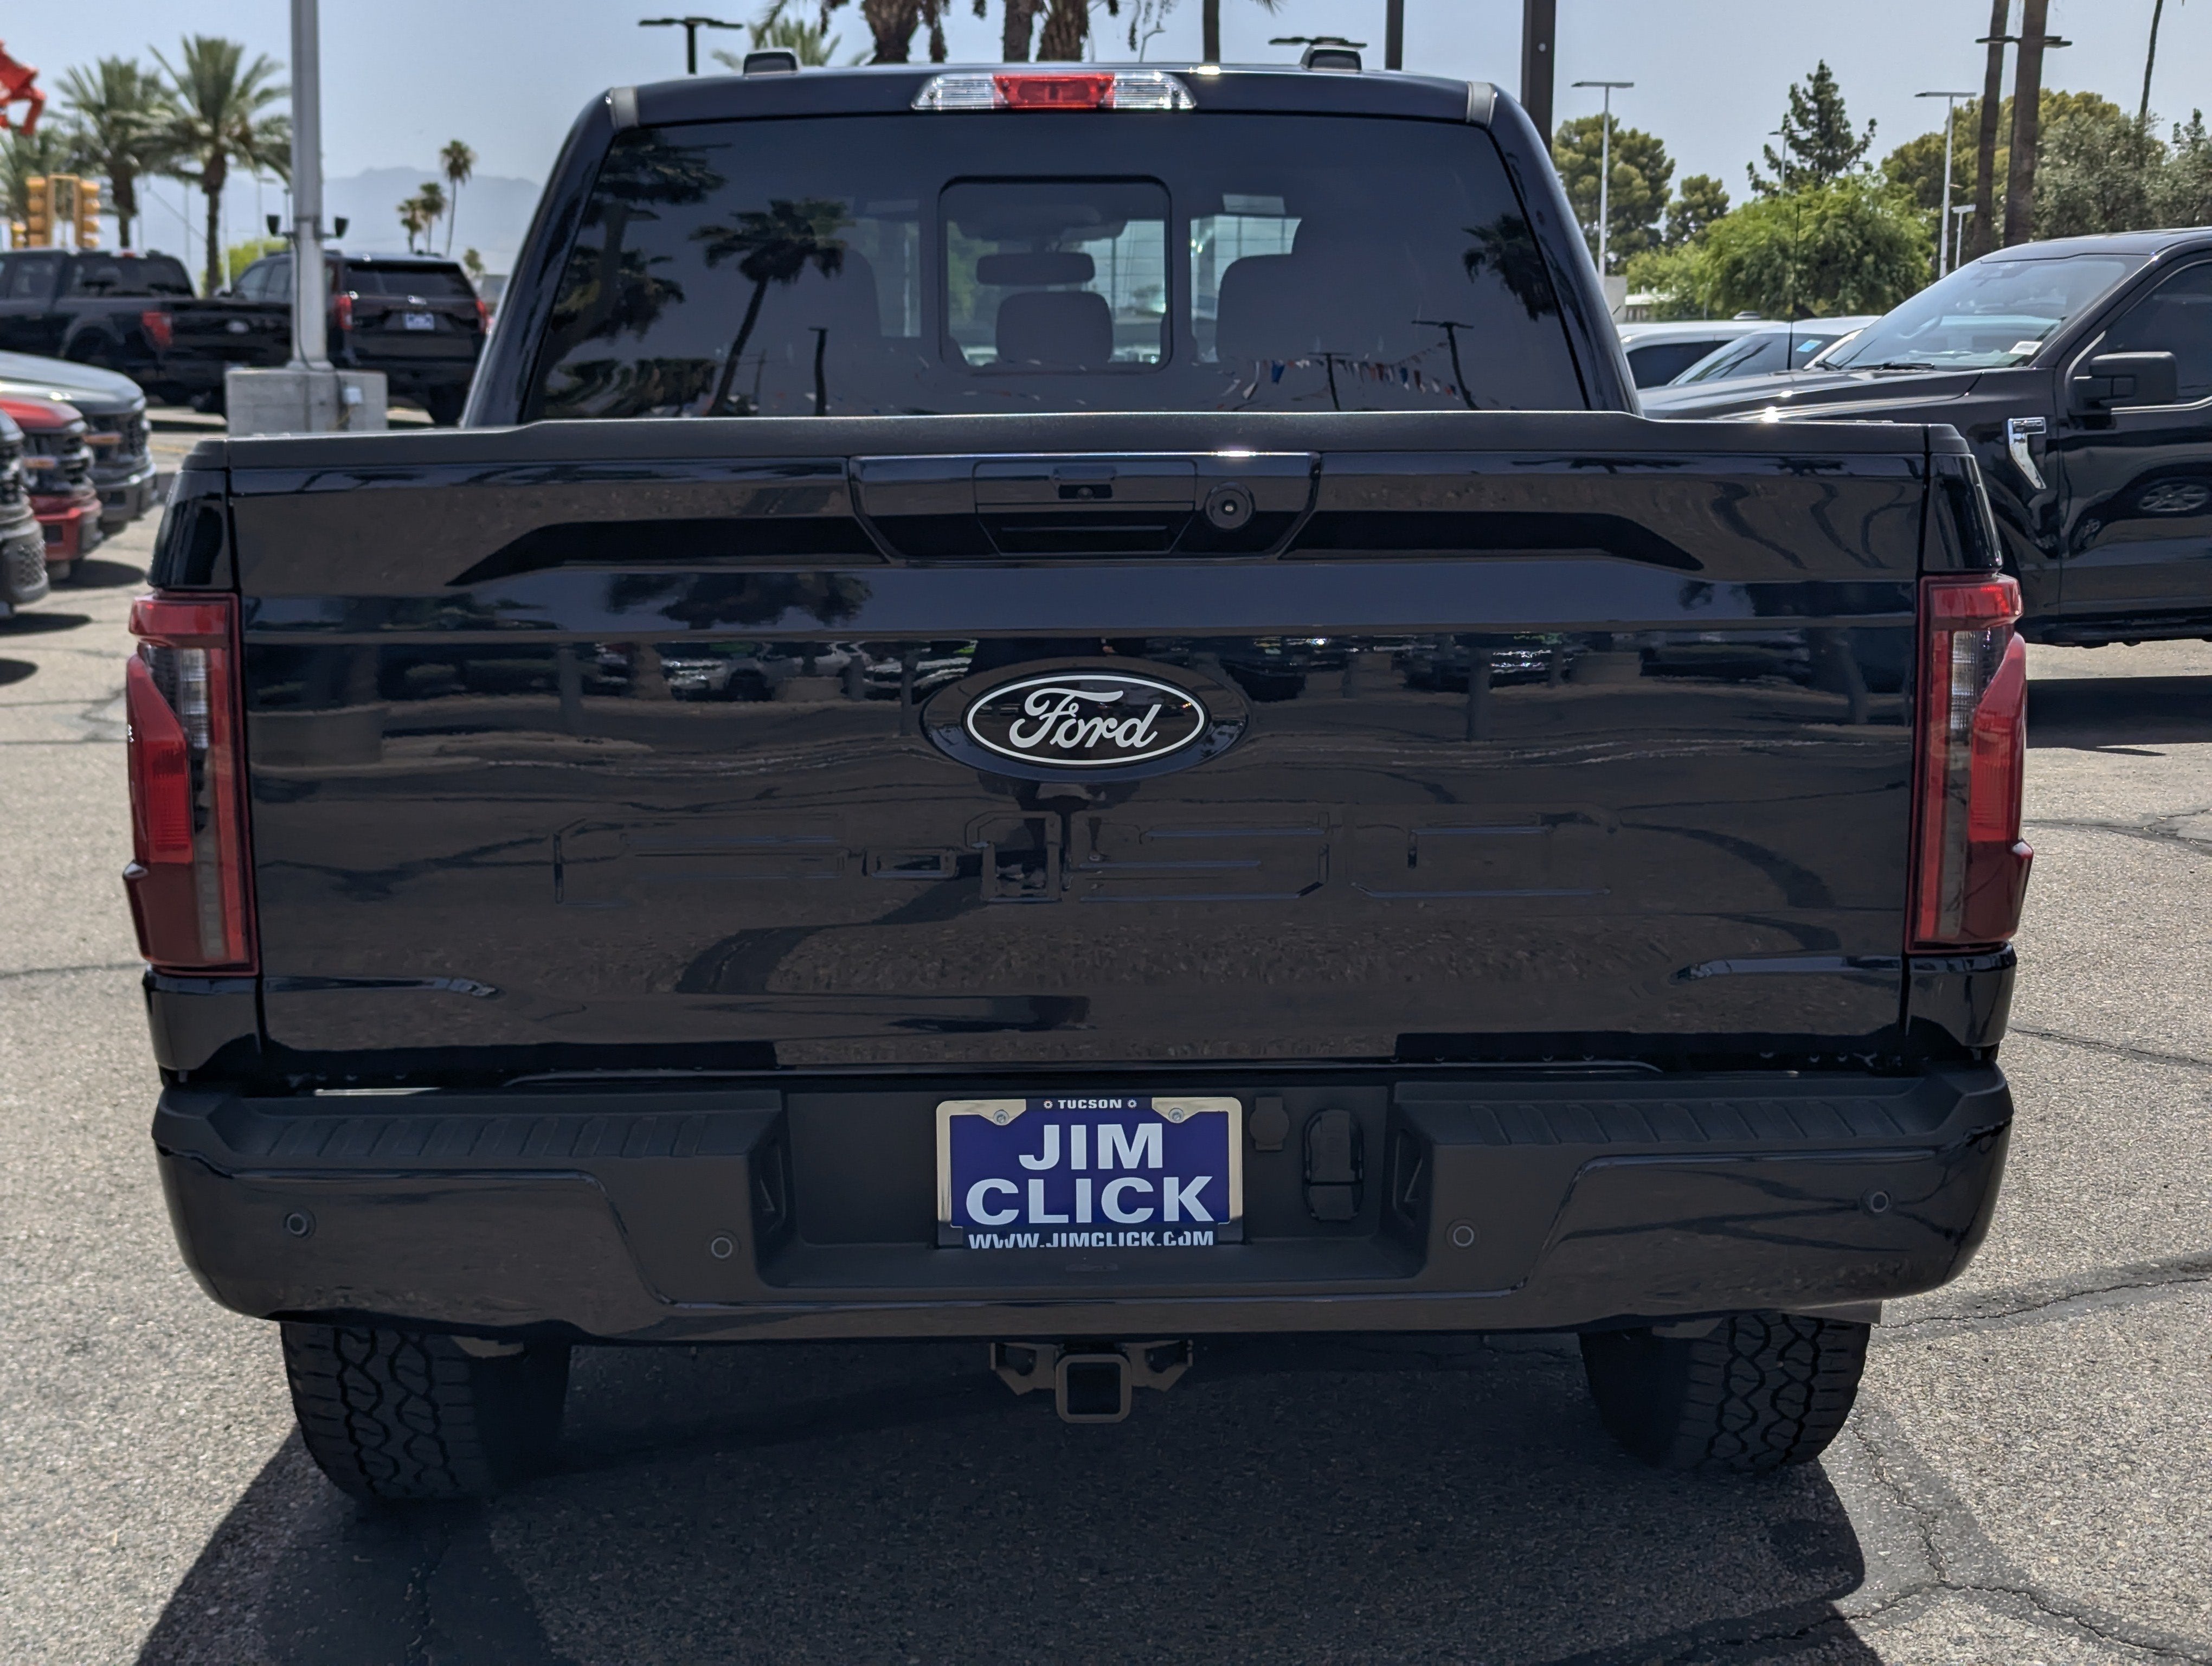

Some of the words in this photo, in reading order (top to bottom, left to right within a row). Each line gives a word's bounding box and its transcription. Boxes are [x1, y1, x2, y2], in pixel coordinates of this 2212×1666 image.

[1009, 687, 1162, 748] Ford
[1057, 1099, 1122, 1109] TUCSON
[1018, 1123, 1163, 1170] JIM
[966, 1176, 1214, 1226] CLICK
[968, 1231, 1214, 1249] WWW.JIMCLICK.COM
